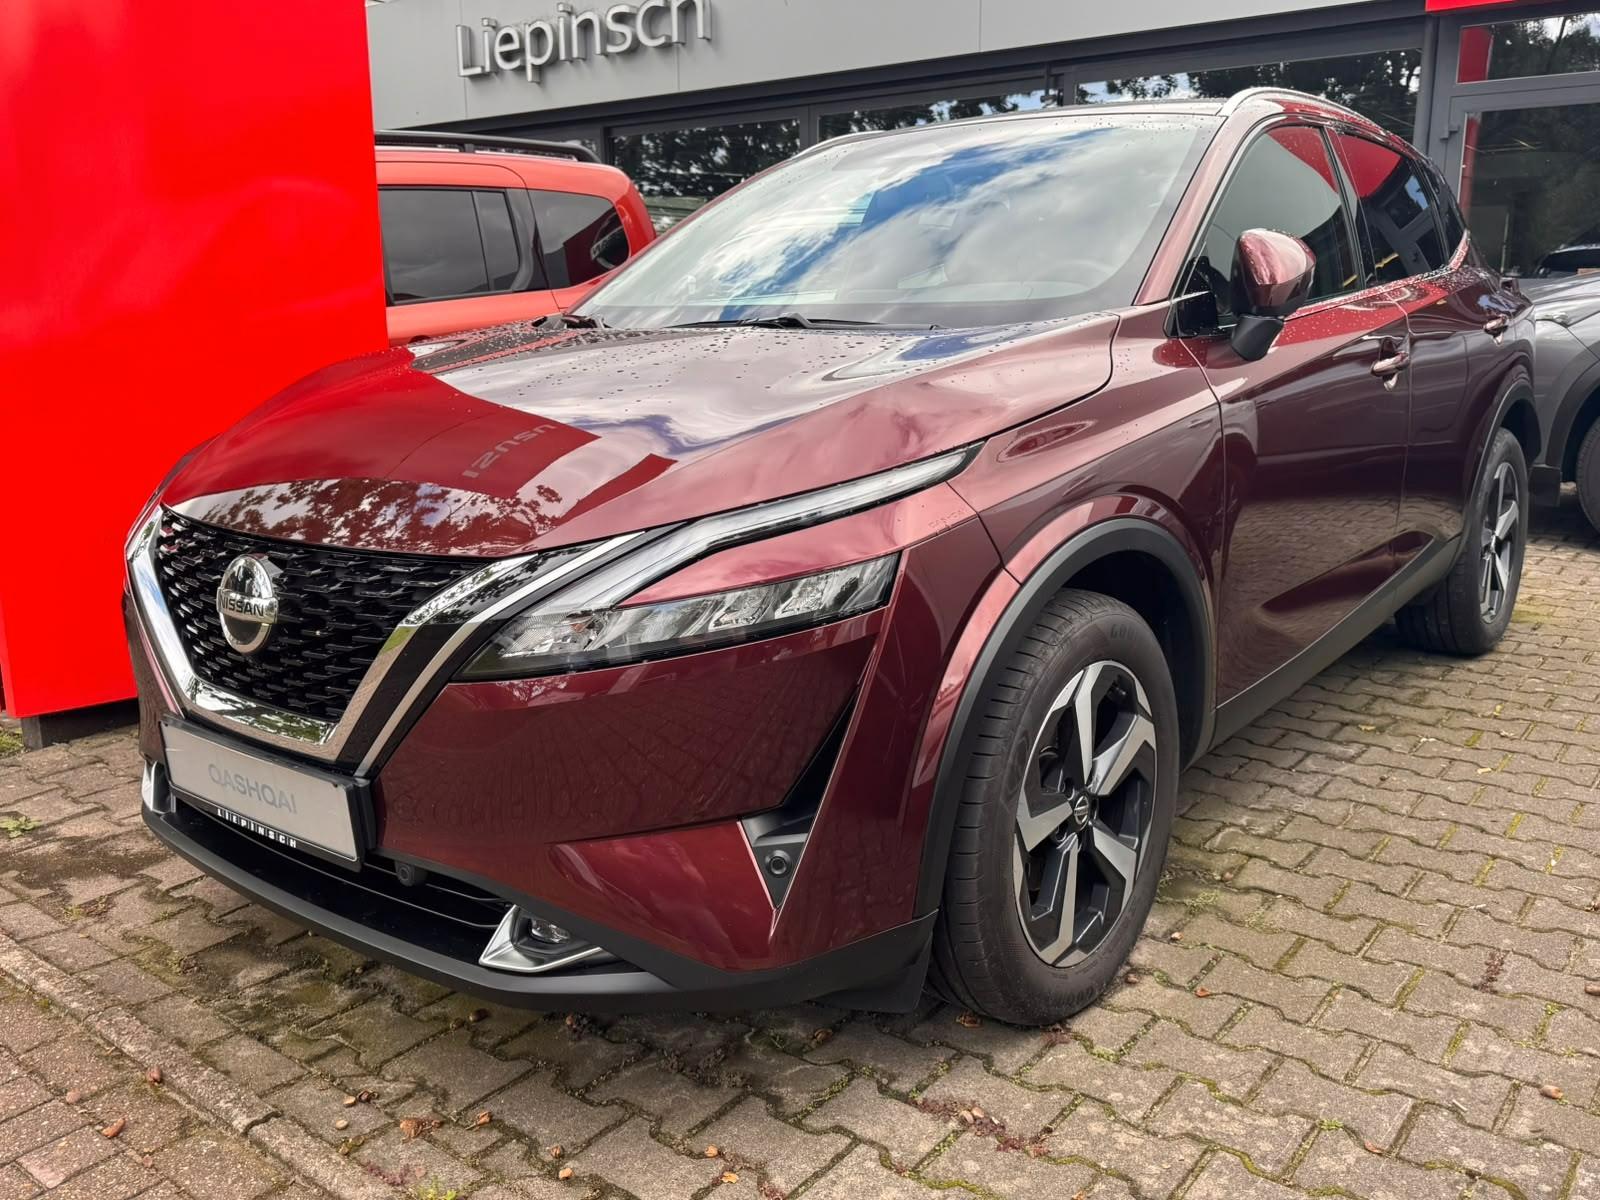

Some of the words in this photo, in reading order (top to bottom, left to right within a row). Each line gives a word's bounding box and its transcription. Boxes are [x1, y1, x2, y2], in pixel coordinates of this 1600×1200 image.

[220, 596, 264, 616] NISSAN
[208, 763, 298, 814] QASHQAI
[217, 809, 297, 848] LIEPINSCH
